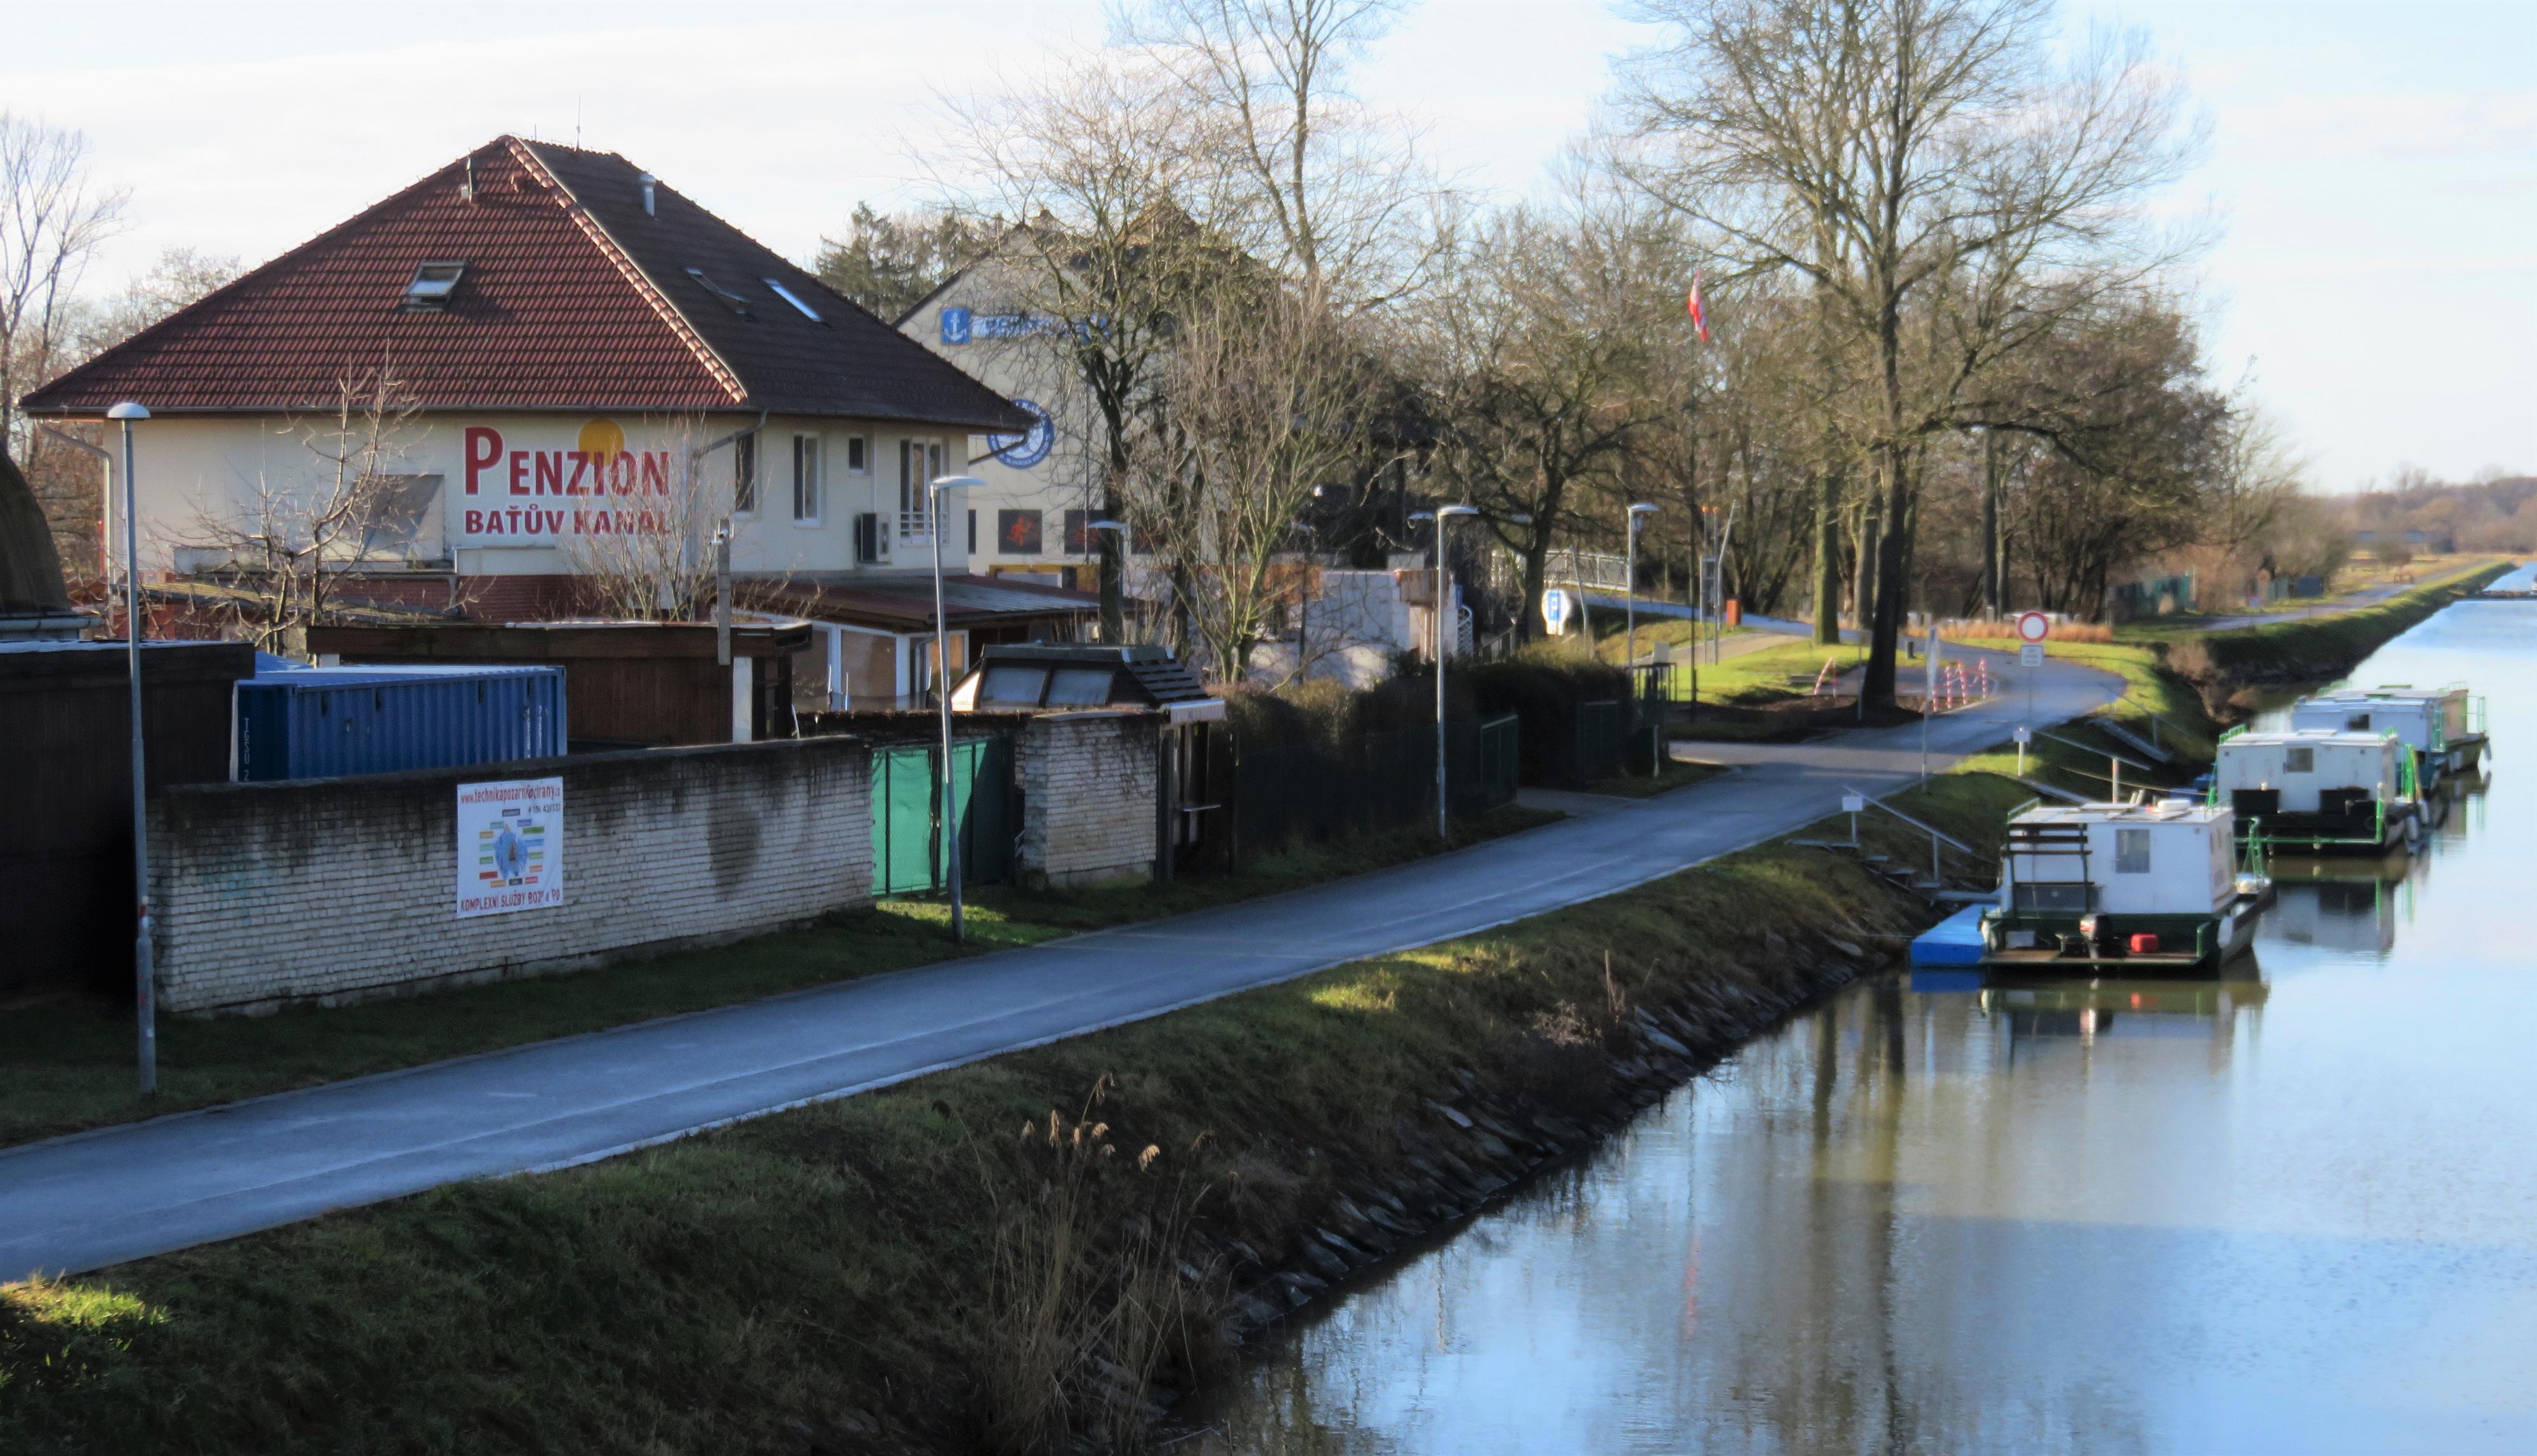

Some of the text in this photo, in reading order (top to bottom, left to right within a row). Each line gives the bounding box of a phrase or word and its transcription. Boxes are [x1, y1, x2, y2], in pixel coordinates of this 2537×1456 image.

[464, 426, 670, 497] PENZION
[465, 503, 564, 535] BAŤŮV
[1551, 597, 1558, 619] P
[460, 893, 499, 912] KOMPLEXNÍ
[501, 890, 526, 907] SLUŽBY
